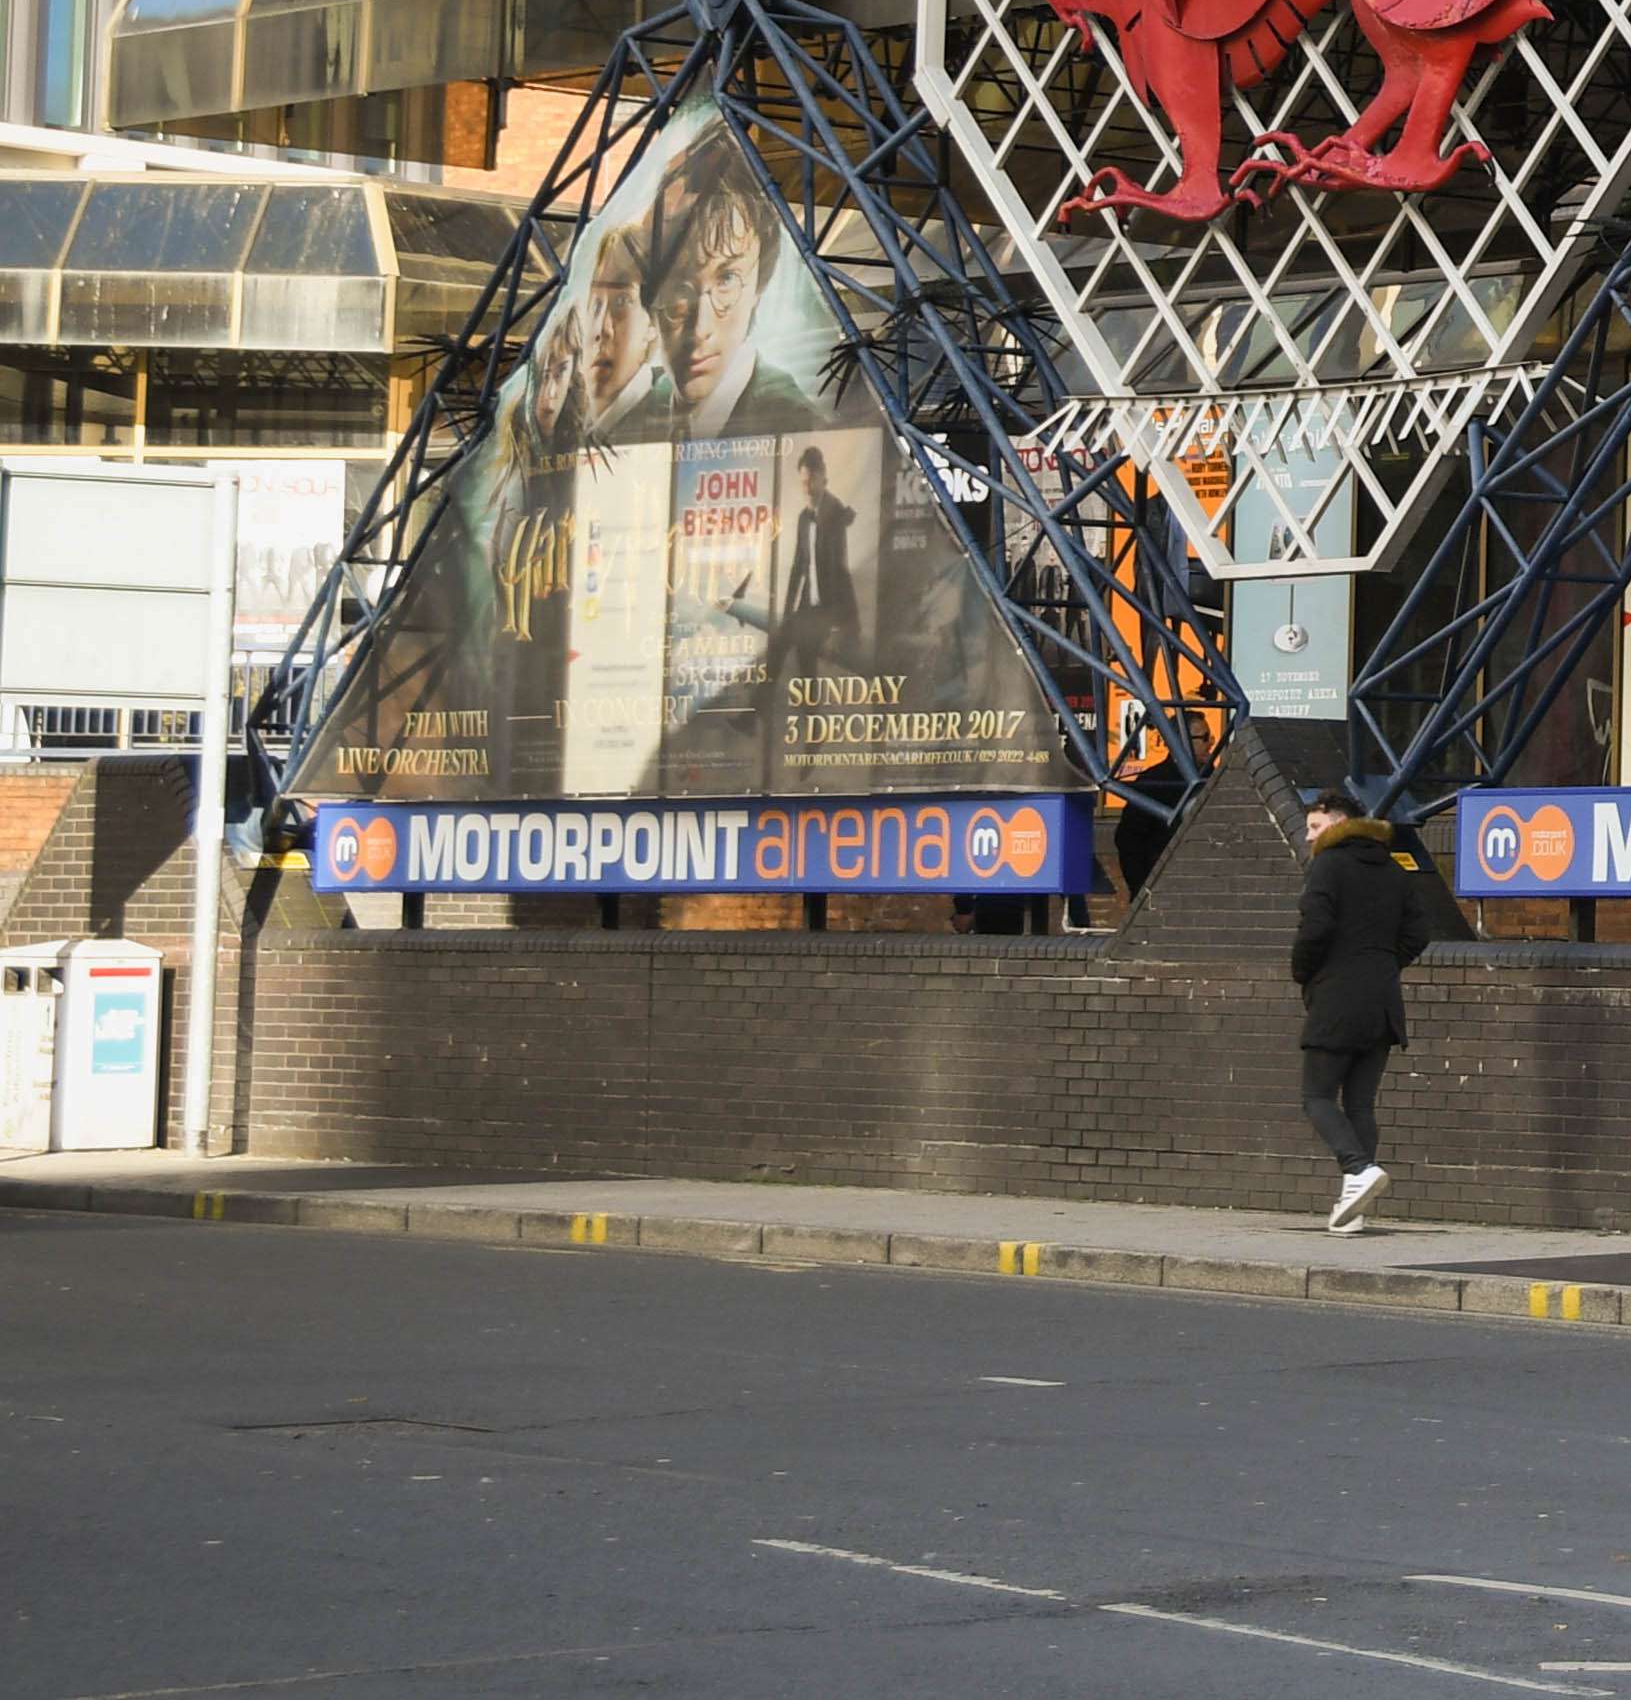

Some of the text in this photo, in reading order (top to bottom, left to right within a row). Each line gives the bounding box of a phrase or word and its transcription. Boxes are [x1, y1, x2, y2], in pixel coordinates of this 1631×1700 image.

[695, 470, 759, 502] JOHN
[683, 505, 770, 537] BISHOP
[787, 675, 908, 708] SUNDAY
[402, 708, 489, 739] FILM WITH
[784, 709, 1027, 745] 3 DECEMBER 2017
[335, 748, 381, 776] LIVE
[383, 747, 490, 777] ORCHESTRA
[998, 750, 1024, 764] 2022
[407, 810, 749, 883] MOTORPOINT
[755, 806, 950, 880] arena
